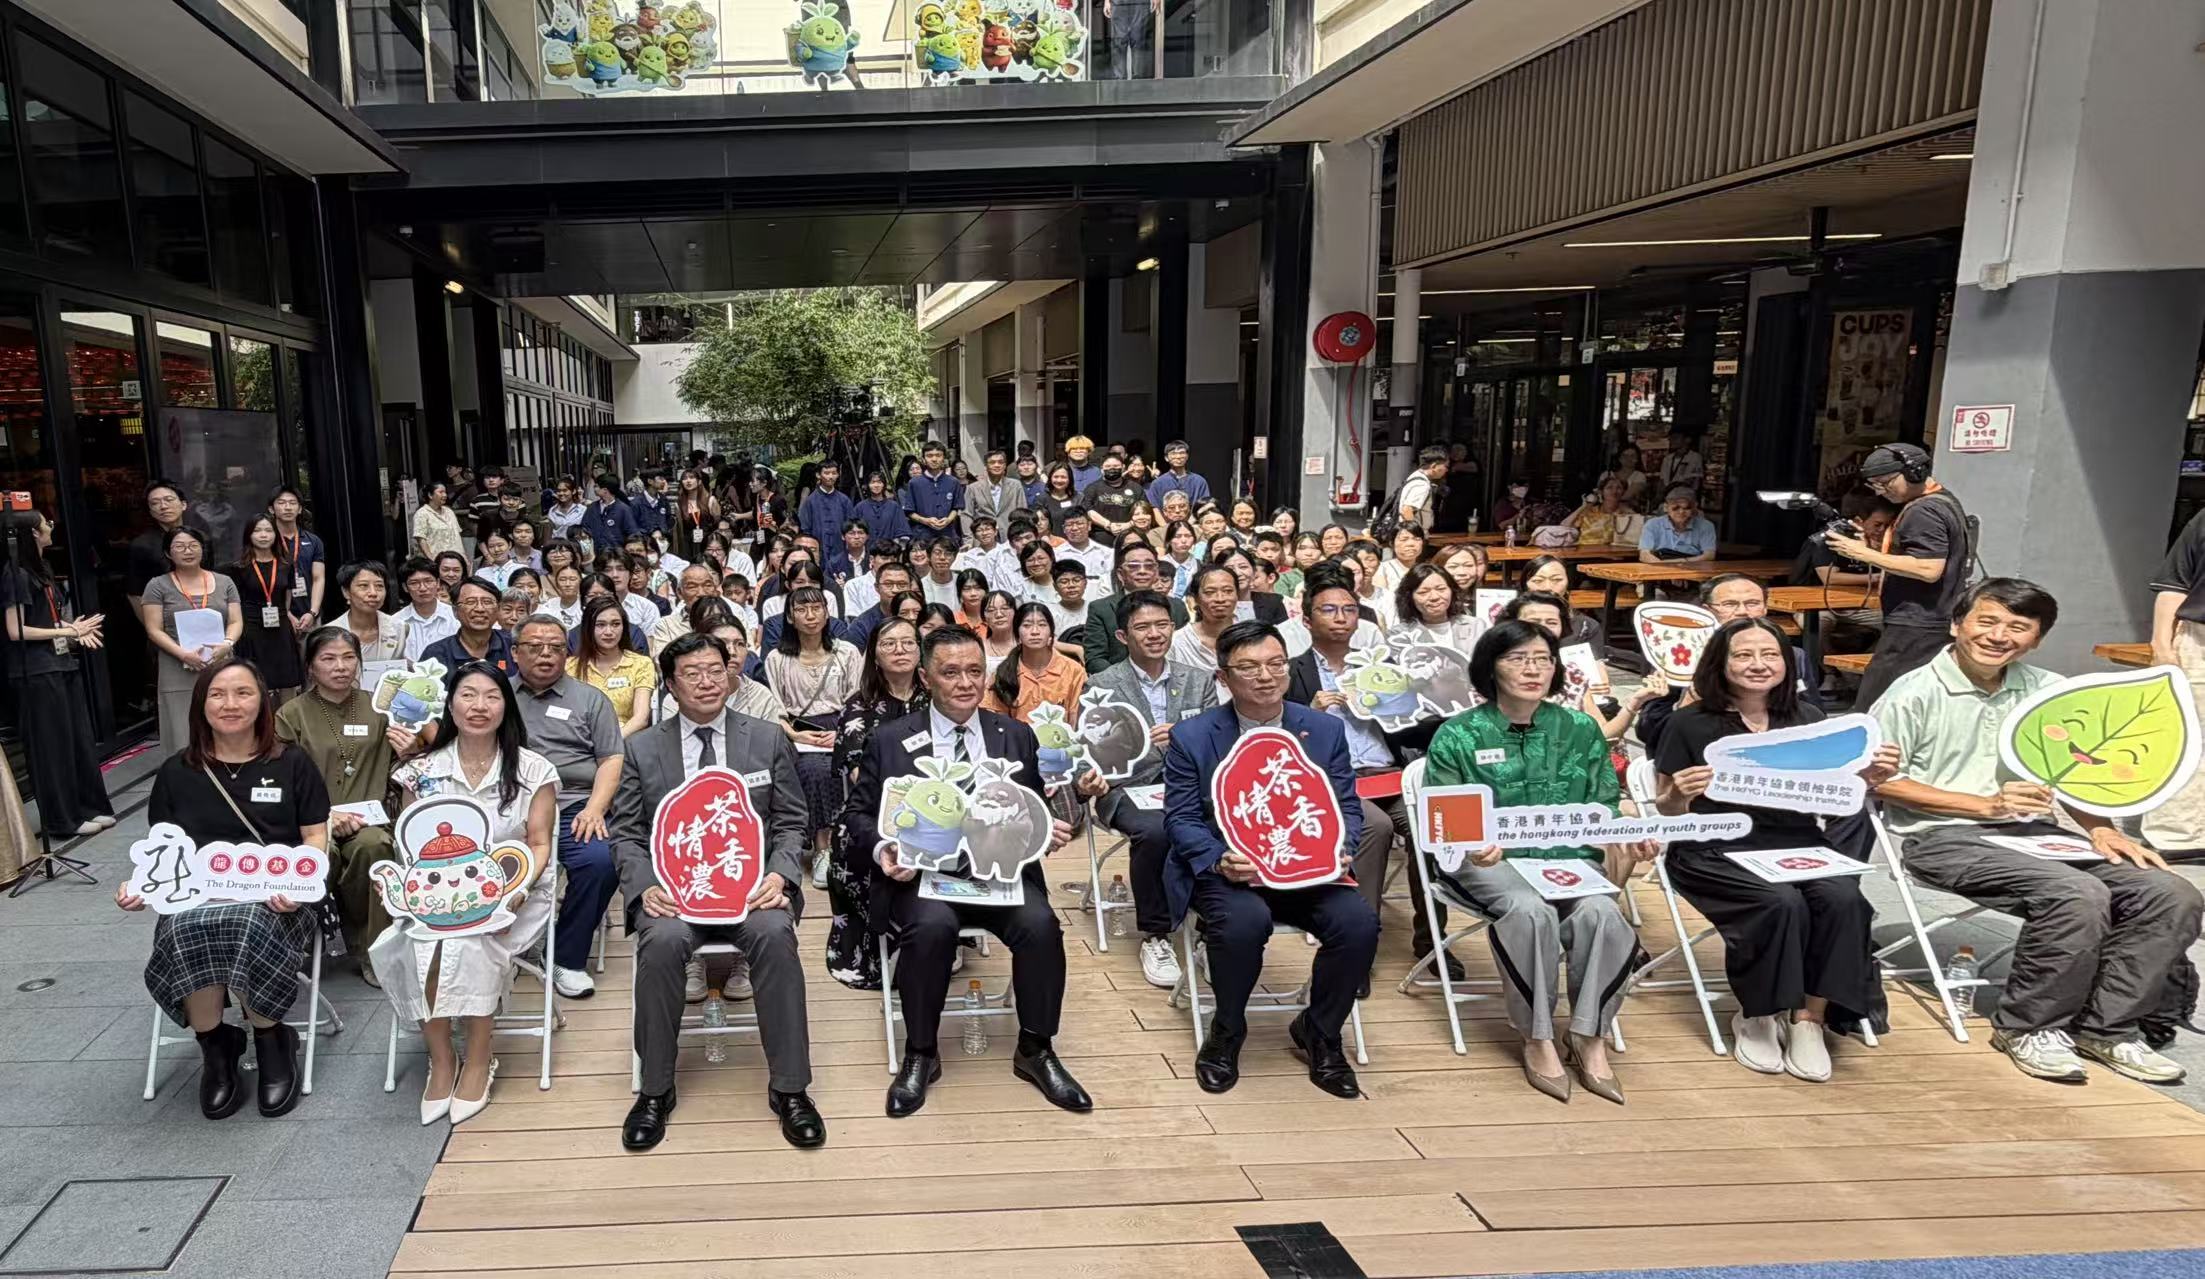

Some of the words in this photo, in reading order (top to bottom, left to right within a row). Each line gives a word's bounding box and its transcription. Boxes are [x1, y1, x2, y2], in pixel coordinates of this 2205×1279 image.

[1839, 314, 1905, 335] CUPS
[1497, 811, 1602, 828] 香港青年協會
[1497, 831, 1517, 841] the
[1520, 829, 1579, 840] hongkong
[1582, 826, 1643, 836] federation
[1647, 824, 1660, 834] of
[1662, 822, 1696, 834] youth
[1700, 821, 1742, 833] groups
[212, 855, 313, 874] 龍傳基金
[205, 879, 224, 888] The
[226, 880, 260, 890] Dragon
[264, 881, 316, 892] Foundation
